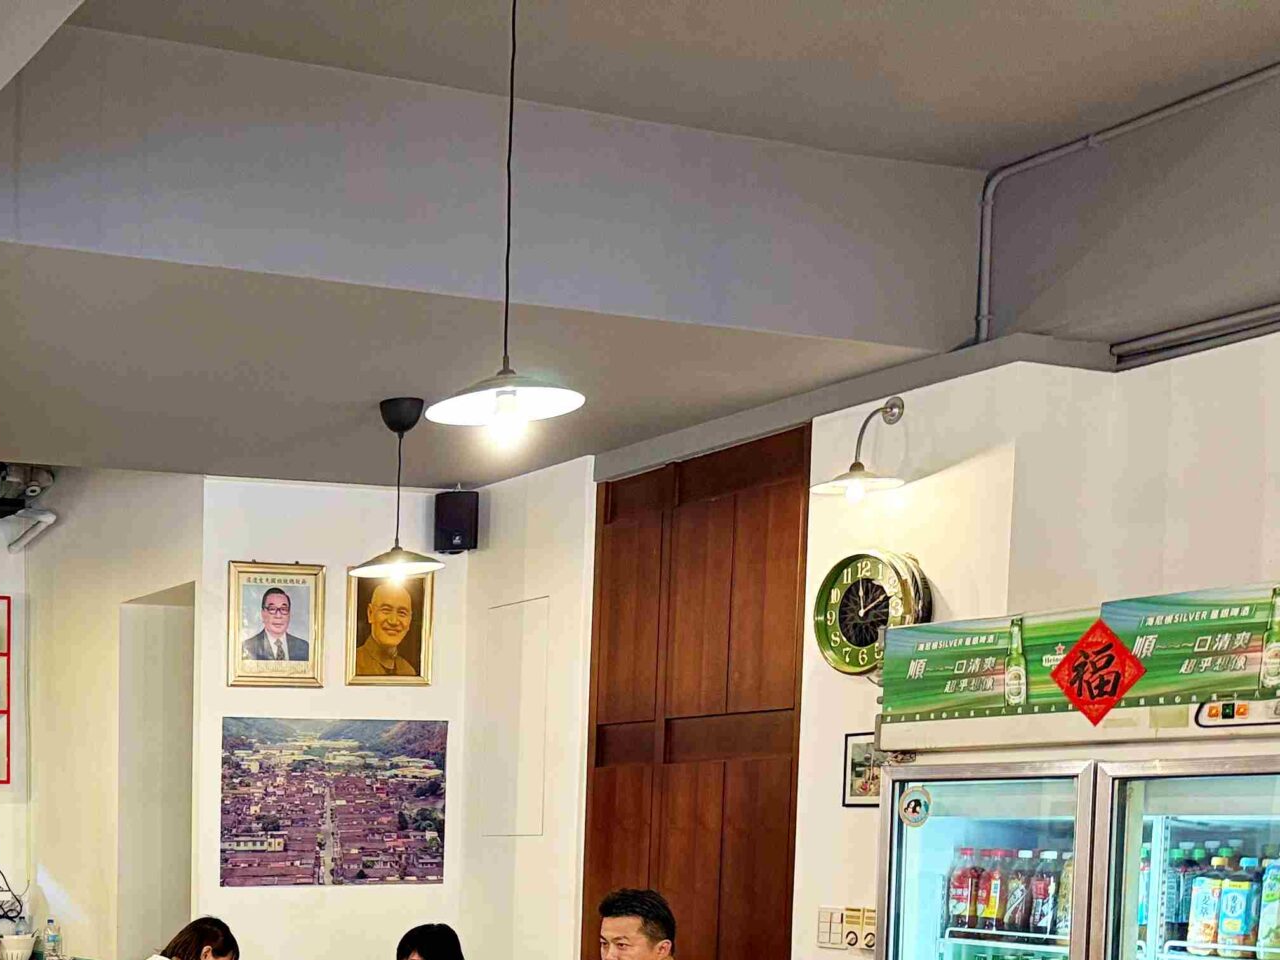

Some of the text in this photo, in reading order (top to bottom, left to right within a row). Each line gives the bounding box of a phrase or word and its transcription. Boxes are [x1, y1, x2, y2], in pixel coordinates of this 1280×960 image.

[842, 567, 852, 584] 11
[857, 560, 871, 578] 12
[830, 588, 841, 604] 10
[826, 610, 836, 626] 9
[830, 631, 841, 647] 8
[842, 647, 852, 663] 7
[858, 649, 868, 665] 6
[1070, 642, 1123, 700] 福
[1179, 655, 1248, 674] 超乎想像
